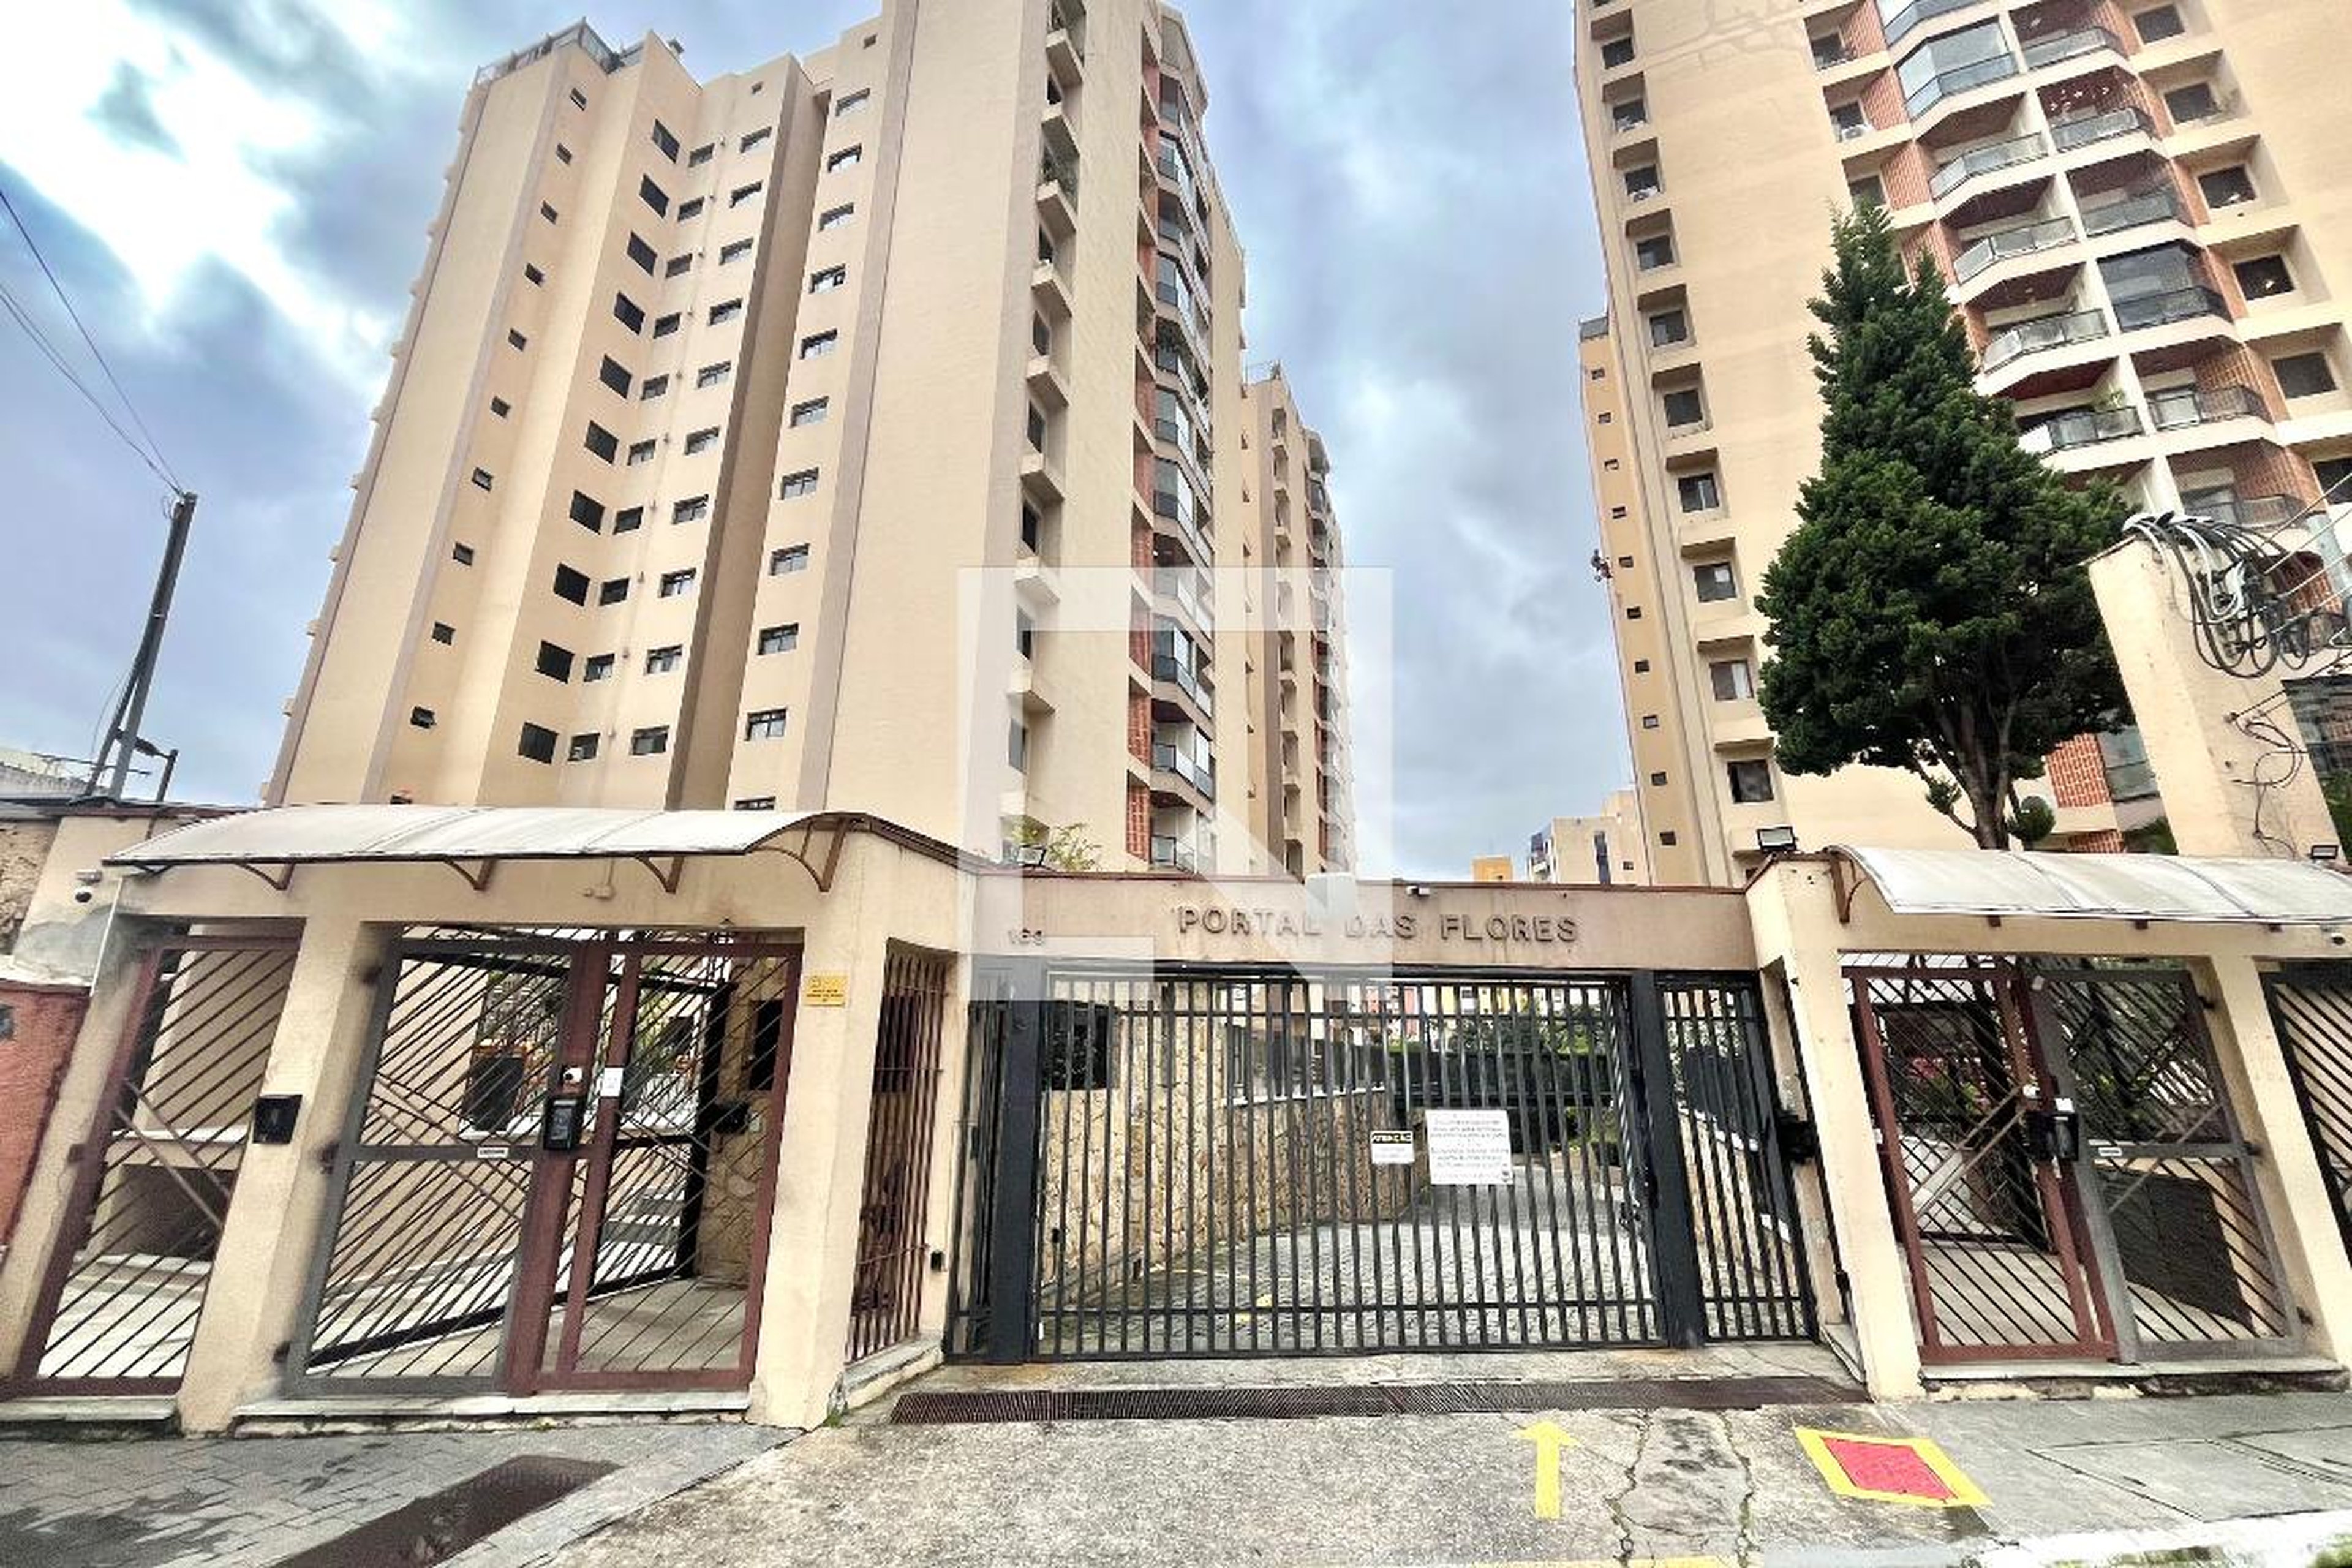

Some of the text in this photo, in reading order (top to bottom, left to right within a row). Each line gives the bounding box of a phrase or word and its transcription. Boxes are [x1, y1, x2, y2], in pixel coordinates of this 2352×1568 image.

[1177, 905, 1580, 944] PORTAL DAS FLORES
